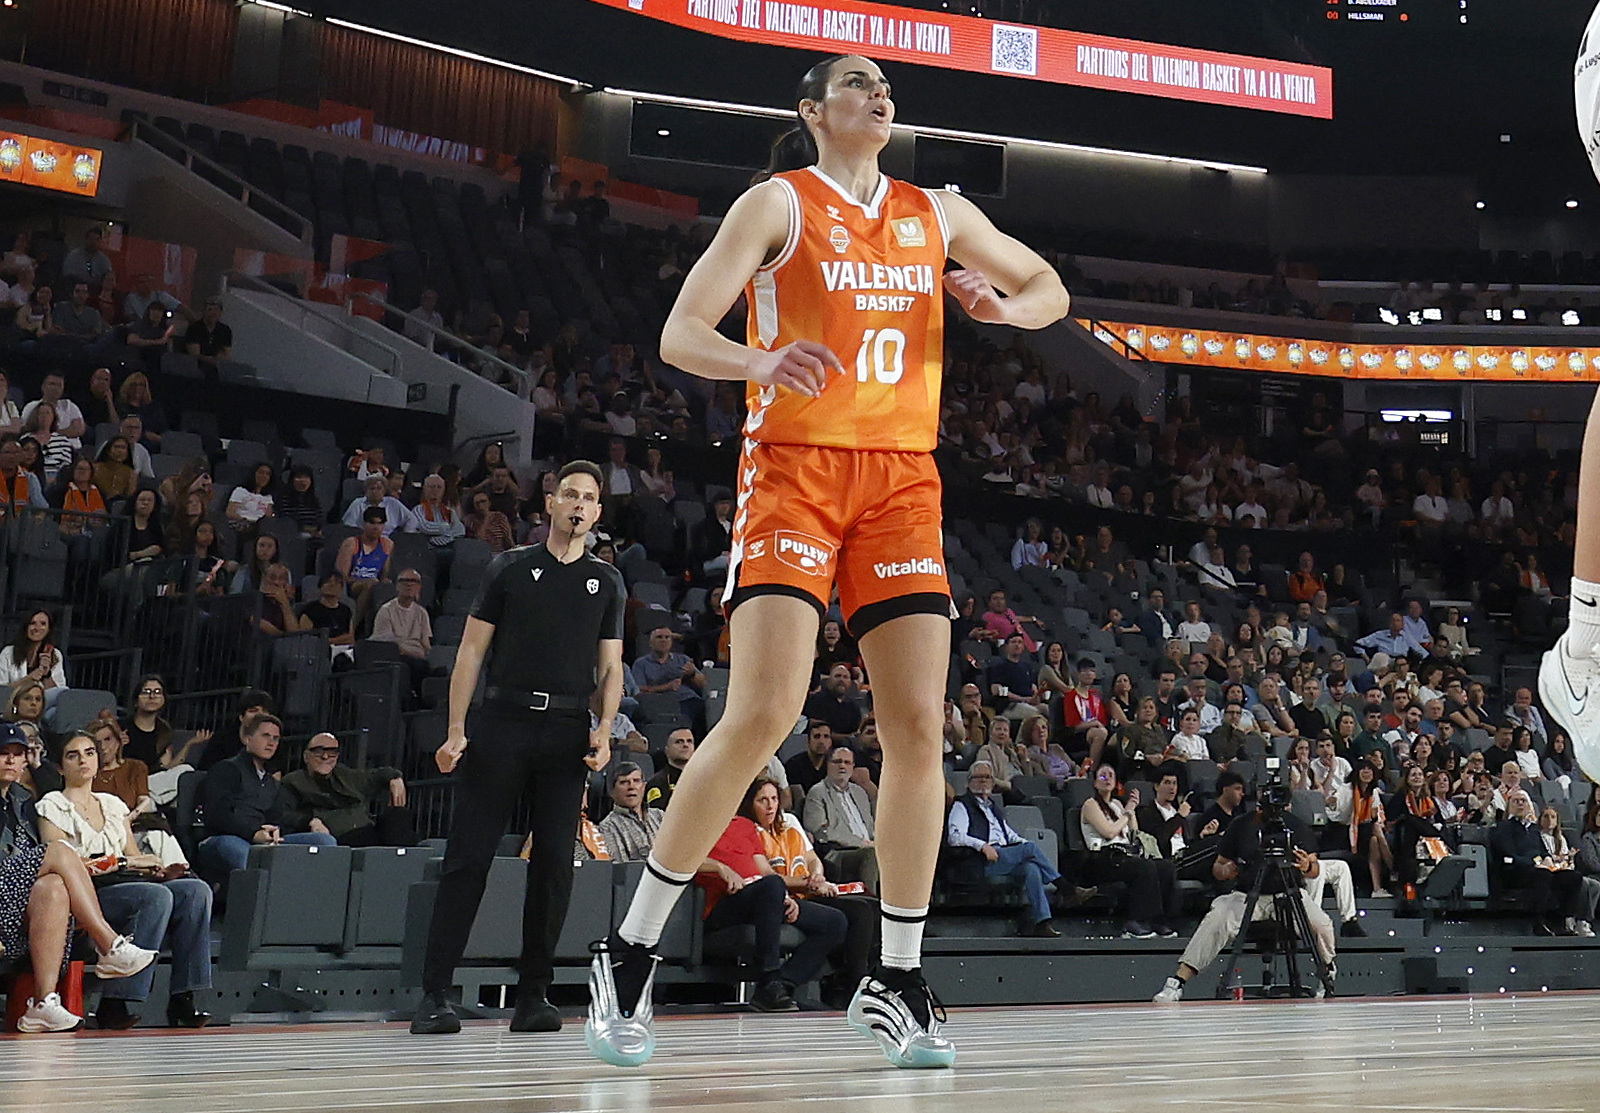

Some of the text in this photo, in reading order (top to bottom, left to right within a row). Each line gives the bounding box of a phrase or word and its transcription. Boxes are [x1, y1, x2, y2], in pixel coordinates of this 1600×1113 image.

[1348, 12, 1384, 21] HILLSMAN
[1460, 15, 1467, 24] 6
[1459, 0, 1467, 9] 3
[765, 1, 819, 38] VALENCIA
[822, 9, 867, 43] BASKET
[869, 15, 884, 46] YA
[886, 18, 895, 48] A
[898, 20, 912, 50] LA
[915, 22, 950, 55] VENTA
[1077, 45, 1316, 105] PARTIDOS DEL VALENCIA BASKET YA A LA VENTA
[820, 261, 935, 297] VALENCIA
[855, 295, 915, 313] BASKET
[856, 328, 906, 385] 10
[779, 538, 829, 565] PULEVA
[873, 558, 942, 579] Vitaldin
